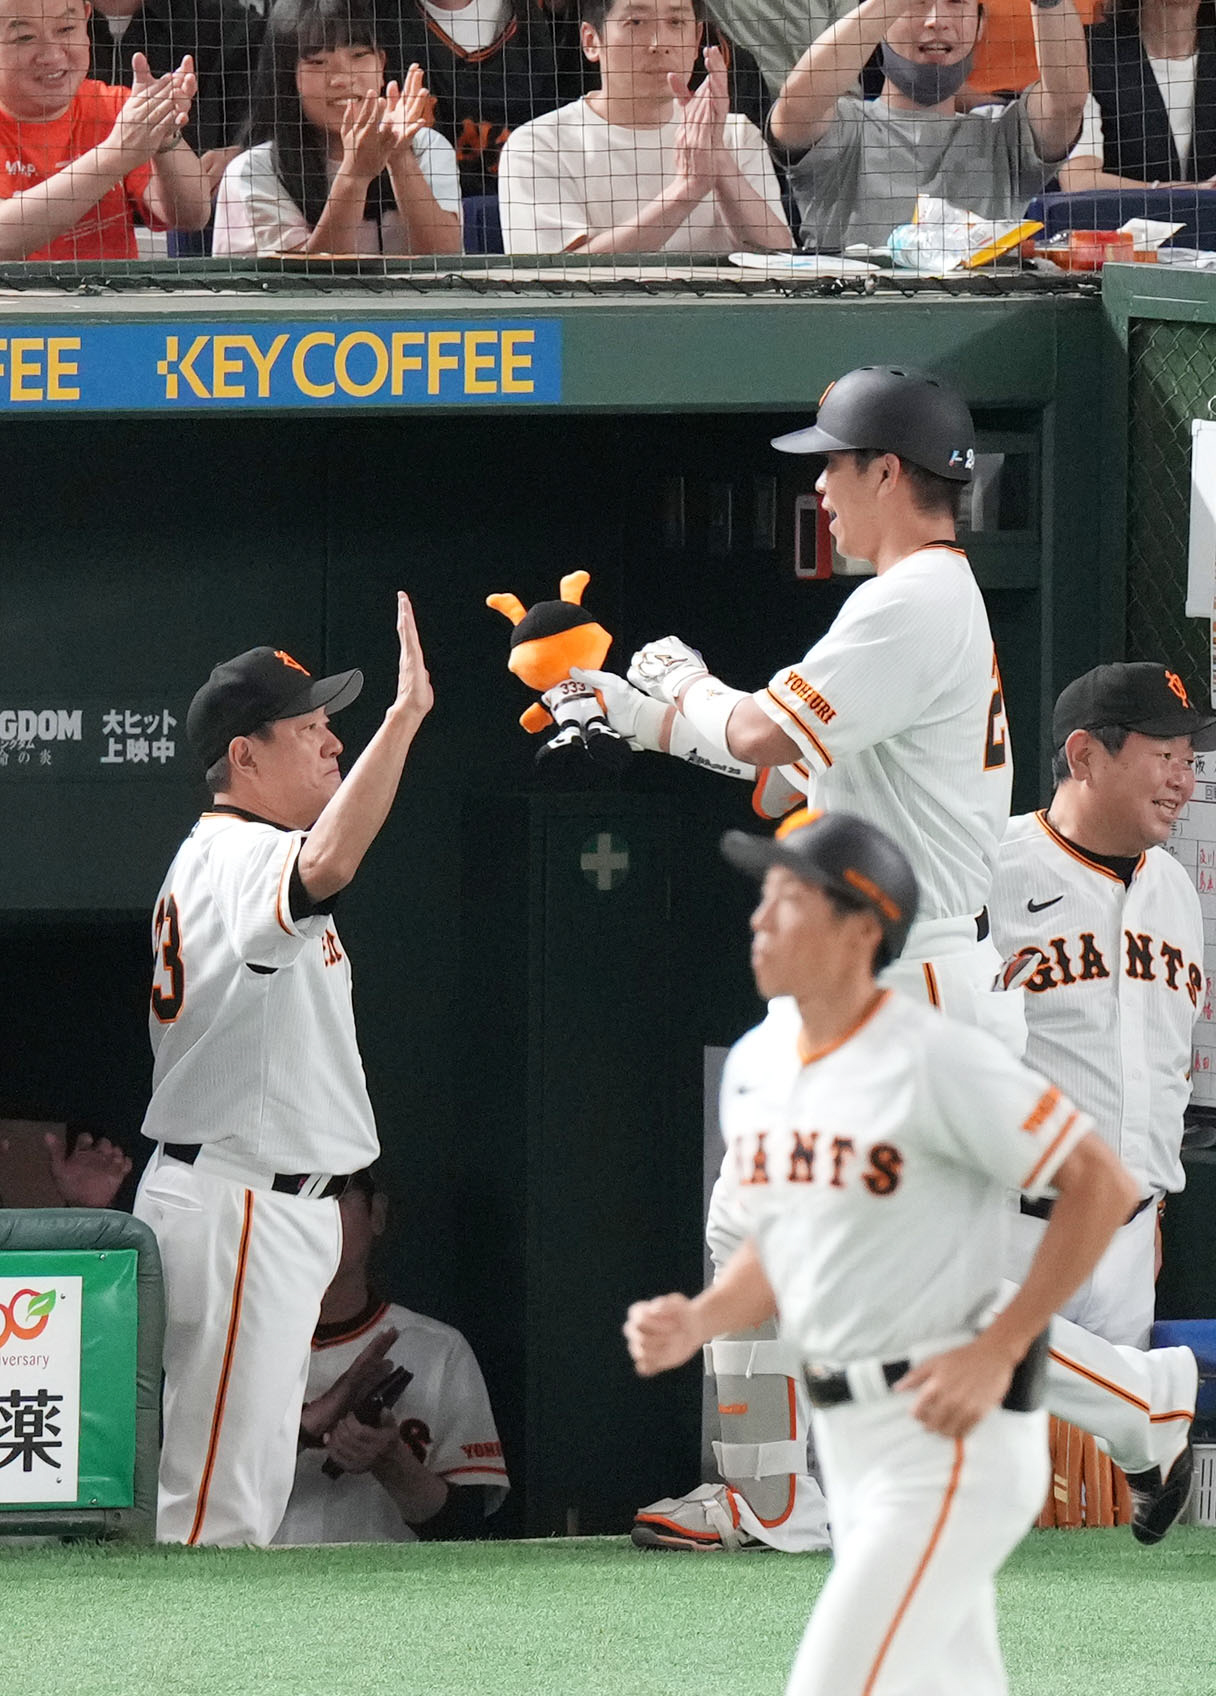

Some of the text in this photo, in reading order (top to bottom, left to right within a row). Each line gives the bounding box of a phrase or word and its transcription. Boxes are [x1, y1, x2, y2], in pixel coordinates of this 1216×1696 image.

[0, 337, 81, 401] EE
[560, 681, 586, 695] 333
[102, 709, 178, 735] 大ヒット
[100, 737, 175, 764] 上映中
